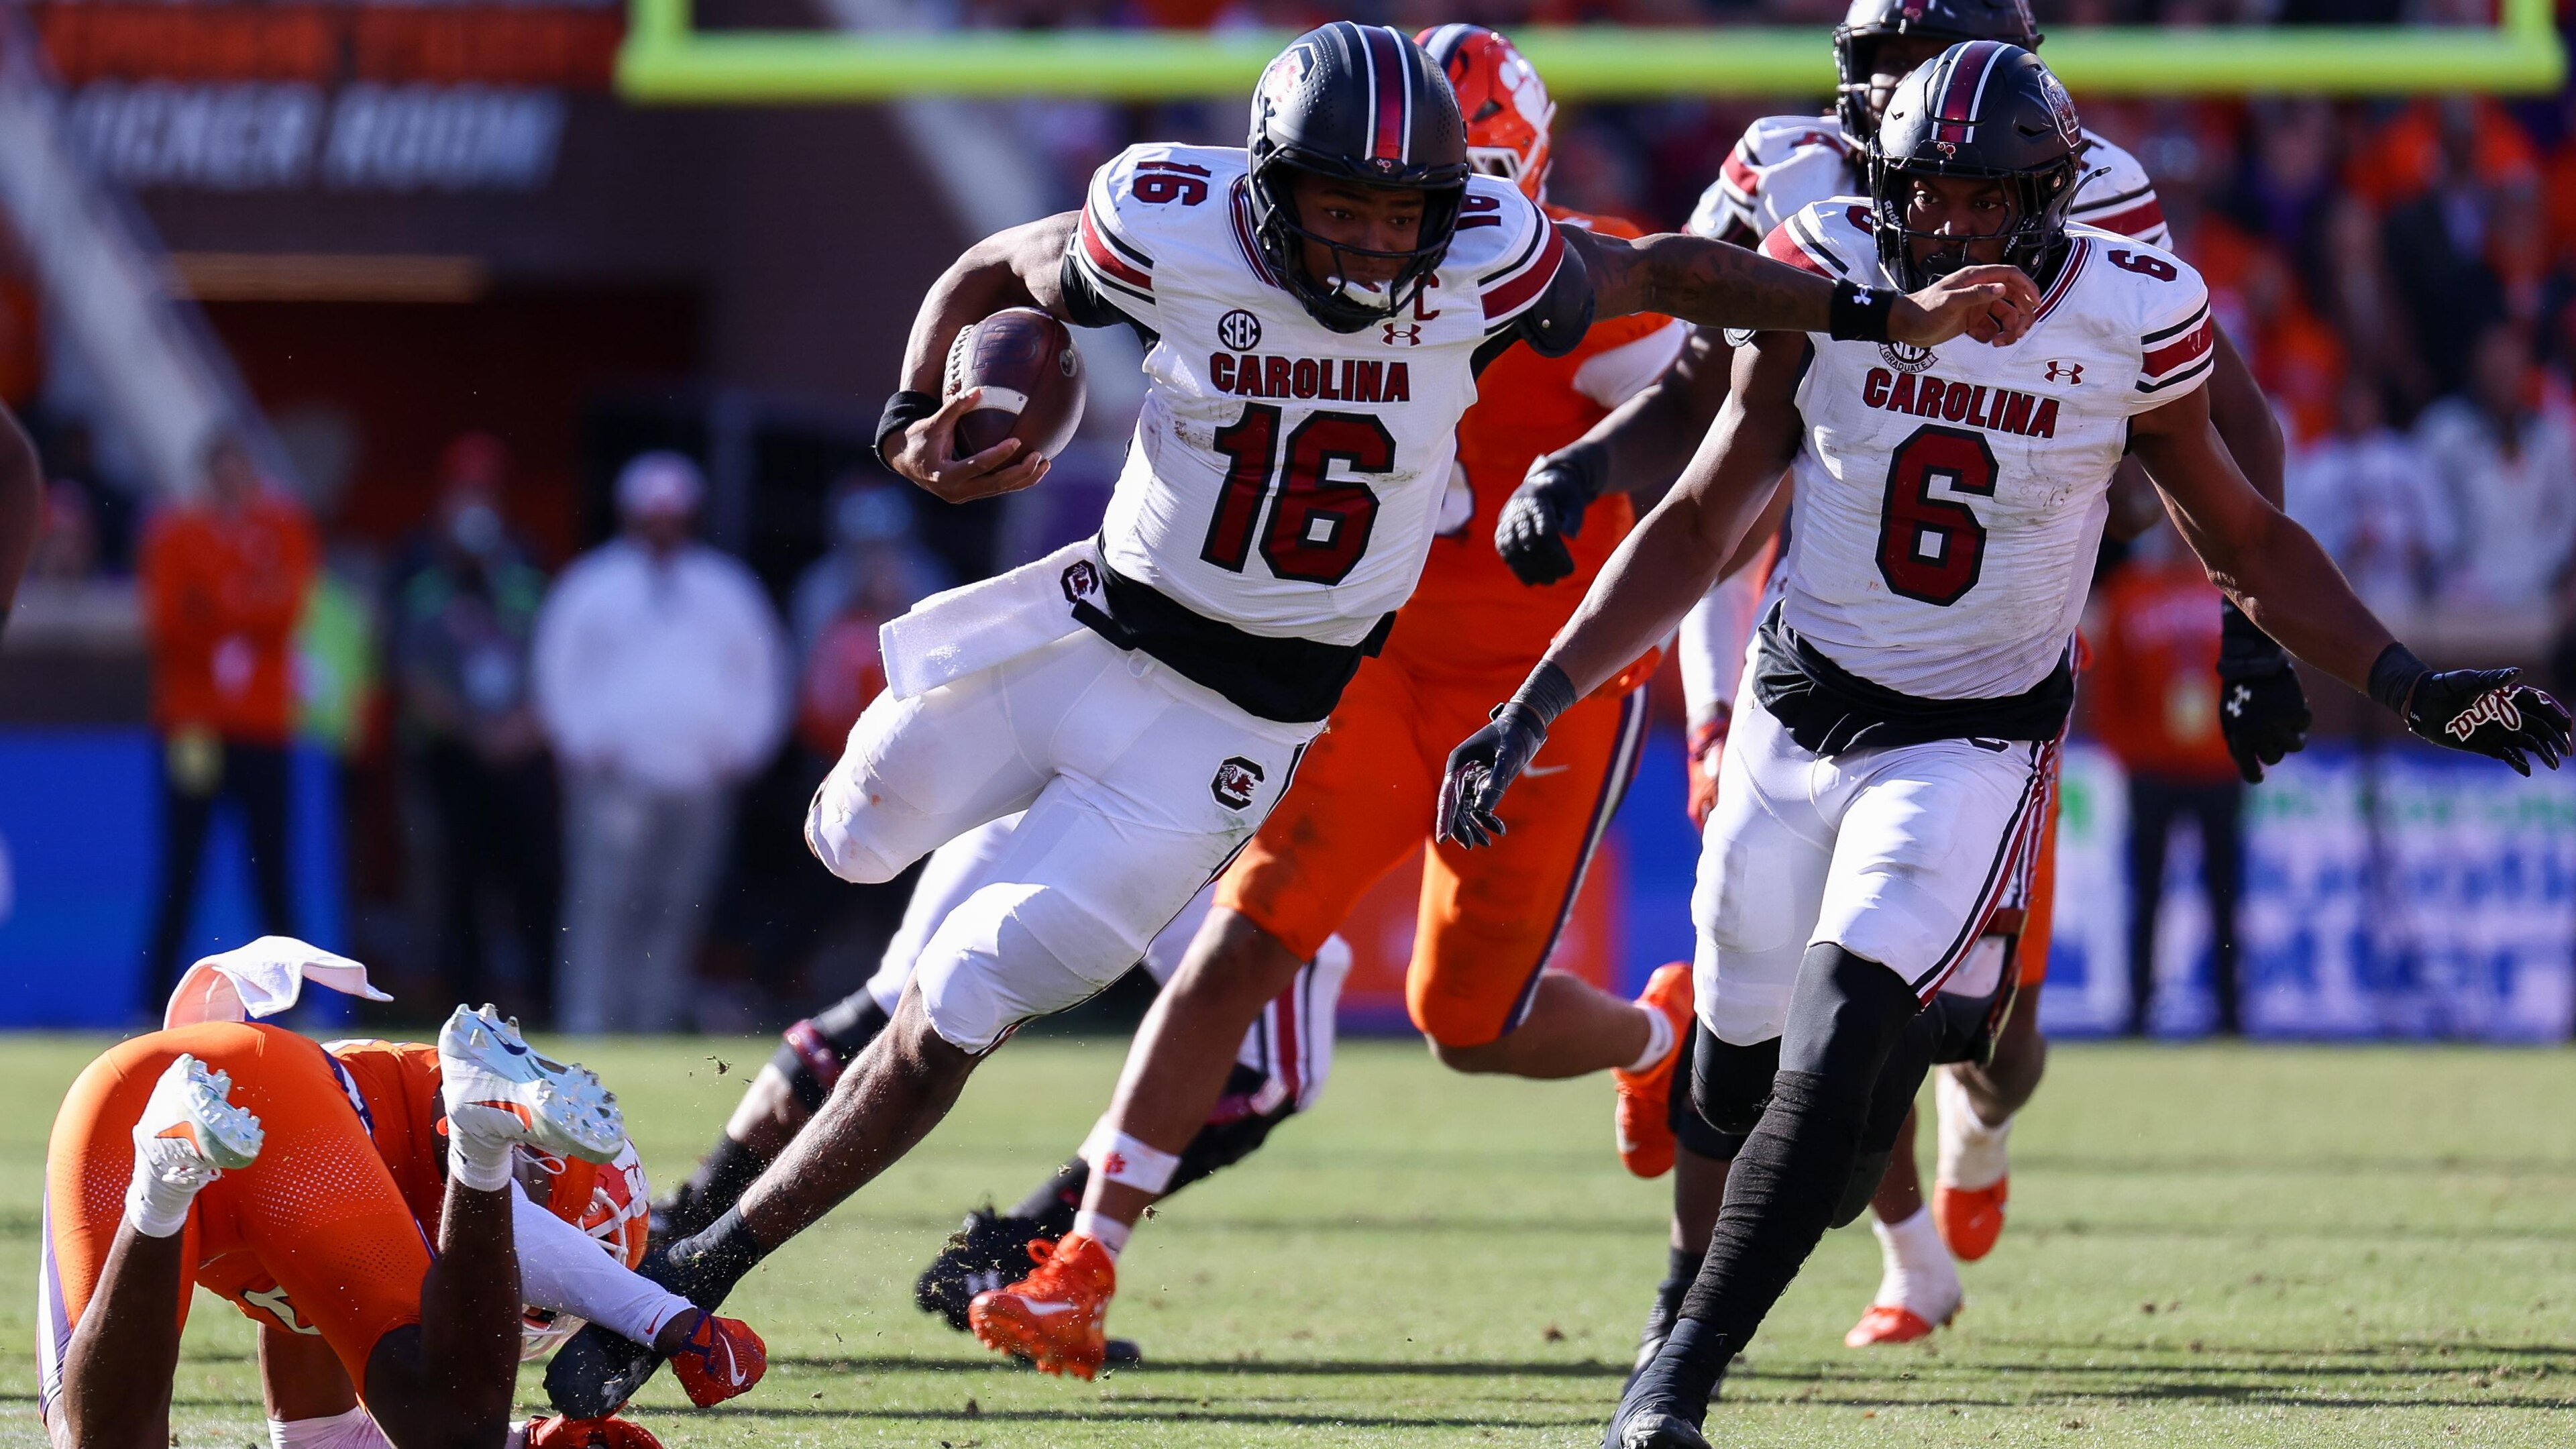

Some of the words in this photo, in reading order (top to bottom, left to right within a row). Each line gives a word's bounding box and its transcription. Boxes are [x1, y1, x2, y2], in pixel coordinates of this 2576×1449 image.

[1132, 161, 1212, 206] 16
[2108, 250, 2178, 282] 6
[1413, 271, 1440, 321] C
[1221, 311, 1258, 349] SEC
[1210, 352, 1410, 402] CAROLINA
[1883, 351, 1928, 372] GRADUATE
[1863, 367, 2059, 439] CAROLINA
[1200, 402, 1396, 586] 16
[1875, 424, 2000, 606] 6
